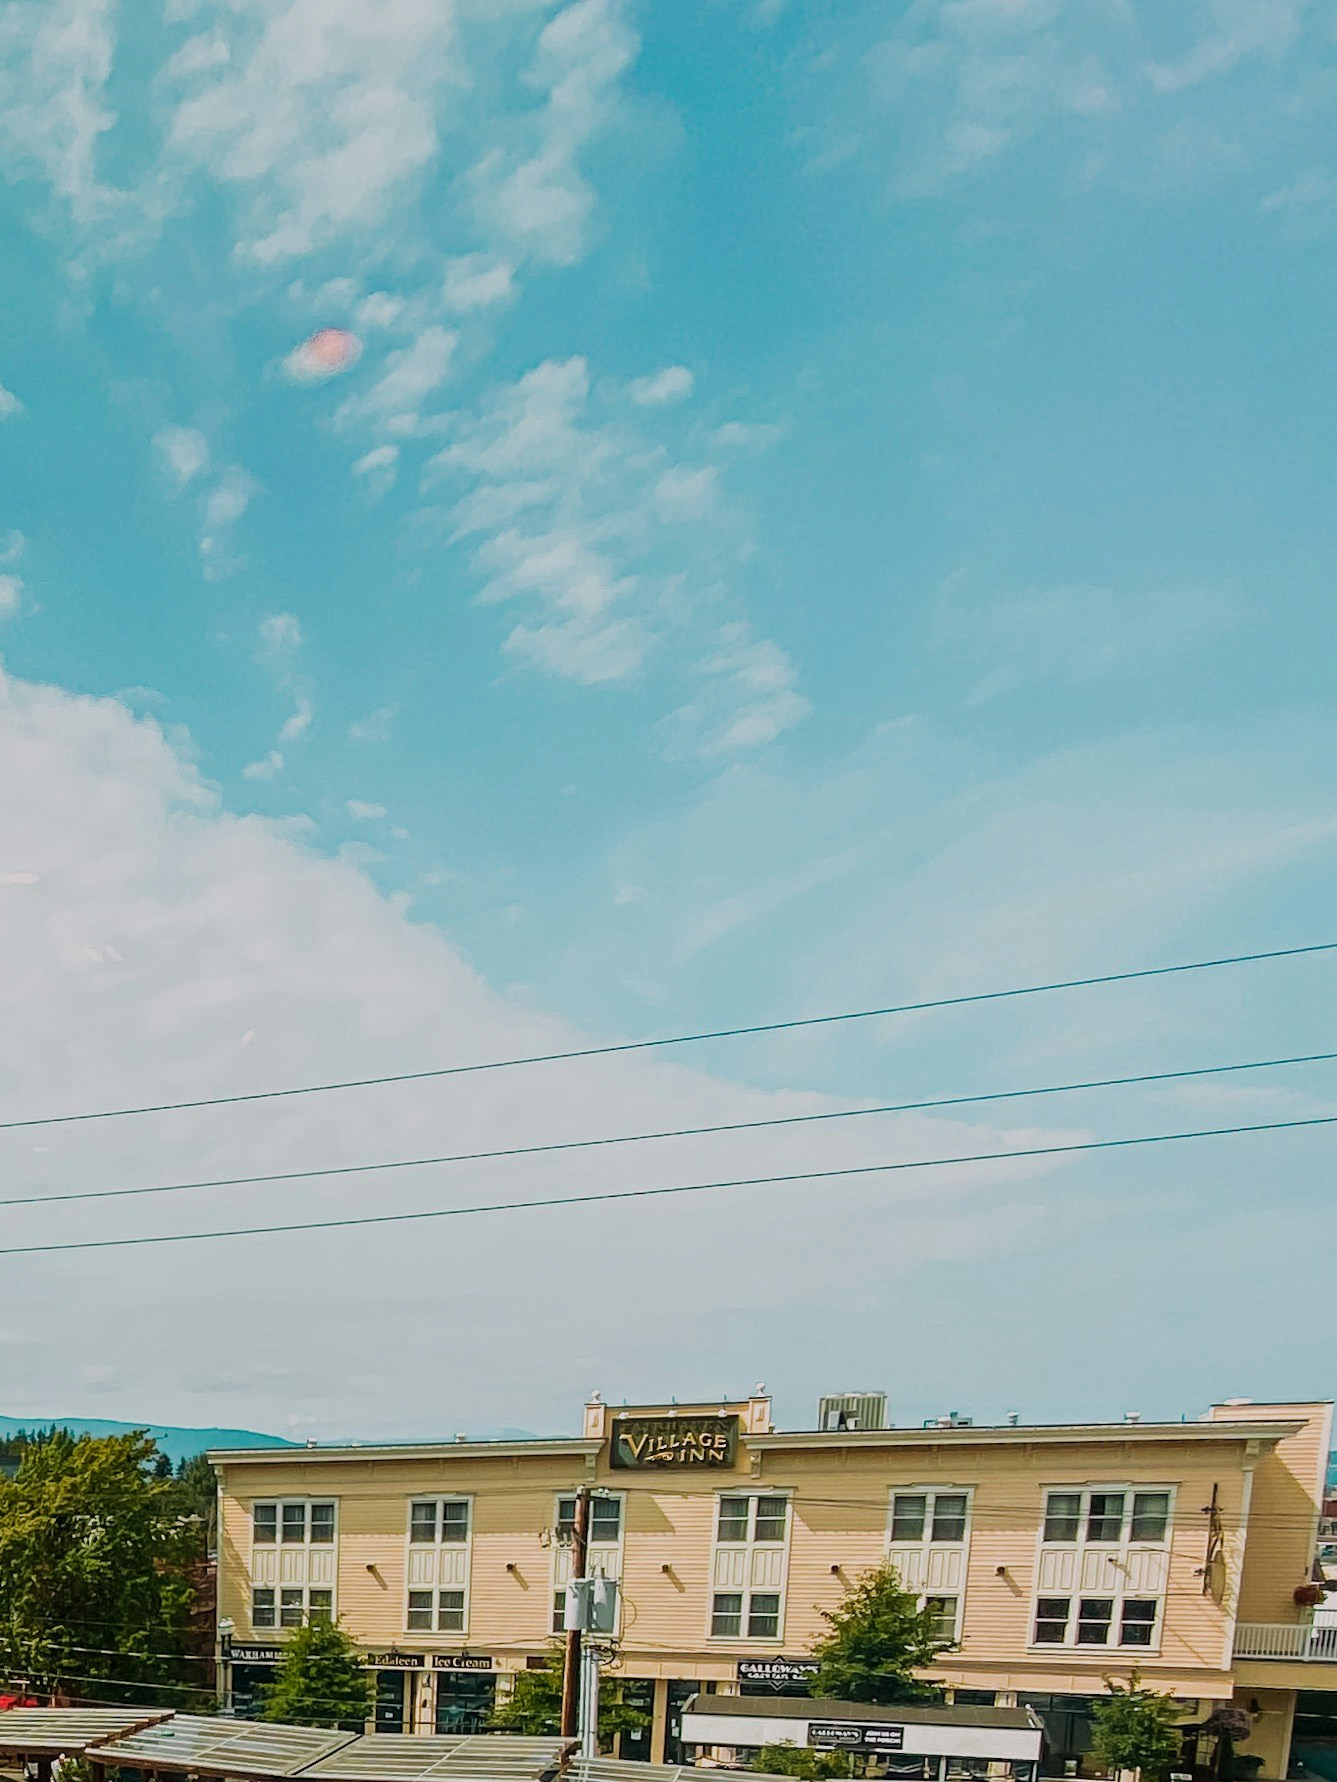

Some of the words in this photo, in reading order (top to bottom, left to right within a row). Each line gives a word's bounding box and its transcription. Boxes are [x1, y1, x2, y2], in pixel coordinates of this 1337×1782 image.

[619, 1432, 727, 1459] VILLAGE
[679, 1448, 725, 1462] INN
[230, 1649, 289, 1659] WARHAM
[374, 1656, 419, 1666] Edaleen
[434, 1656, 451, 1667] Ice
[452, 1657, 491, 1669] Cream
